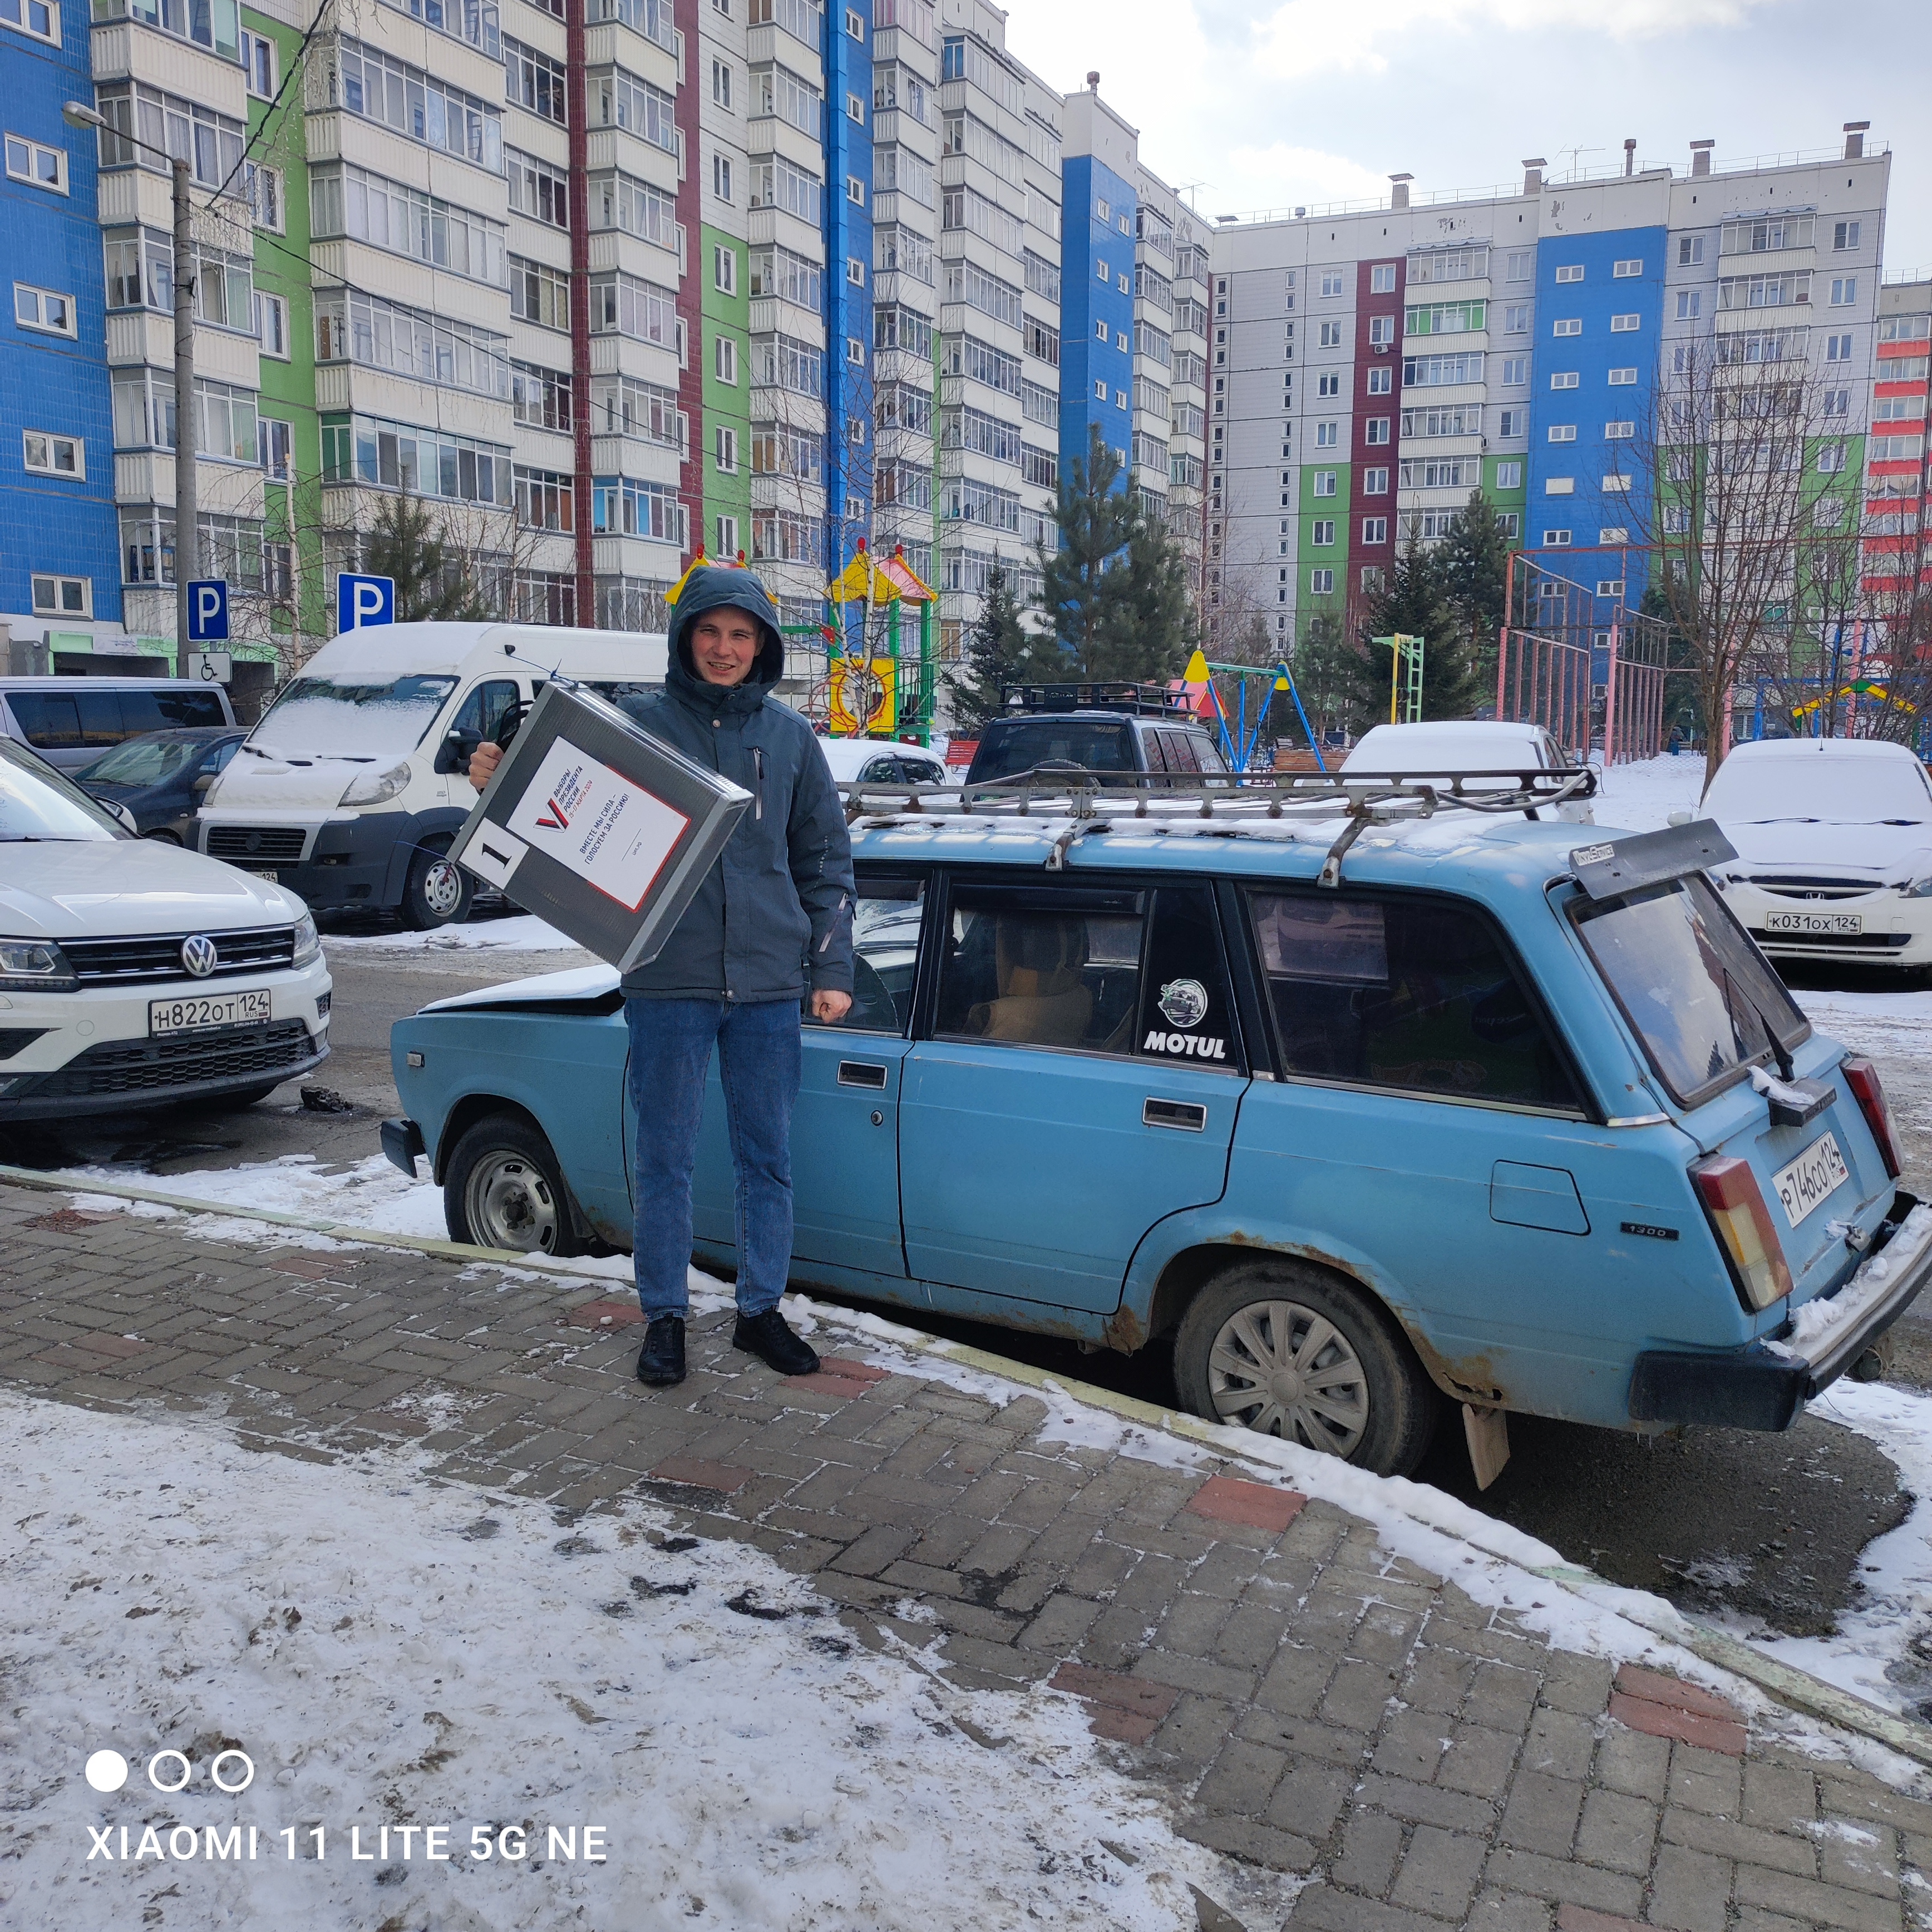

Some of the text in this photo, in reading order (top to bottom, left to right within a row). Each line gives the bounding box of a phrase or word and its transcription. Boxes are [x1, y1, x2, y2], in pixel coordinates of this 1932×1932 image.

[198, 587, 220, 634] P
[354, 581, 384, 628] P
[553, 768, 571, 797] ВЫБОРЫ
[558, 765, 583, 805] ПРЕЗИДЕНТА
[563, 786, 580, 812] РОССИИ
[575, 790, 587, 807] МАРТА
[579, 828, 597, 854] ВМЕСТЕ
[593, 816, 604, 830] МЫ
[600, 799, 615, 817] СИЛА
[584, 793, 630, 865] ГОЛОСУЕМ ЗА РОССИЮ!
[481, 842, 512, 870] 1
[1835, 917, 1857, 928] 124
[239, 993, 266, 1012] 124
[1144, 1031, 1225, 1059] MOTUL
[1821, 1137, 1840, 1171] 124
[1629, 1225, 1666, 1236] 1300
